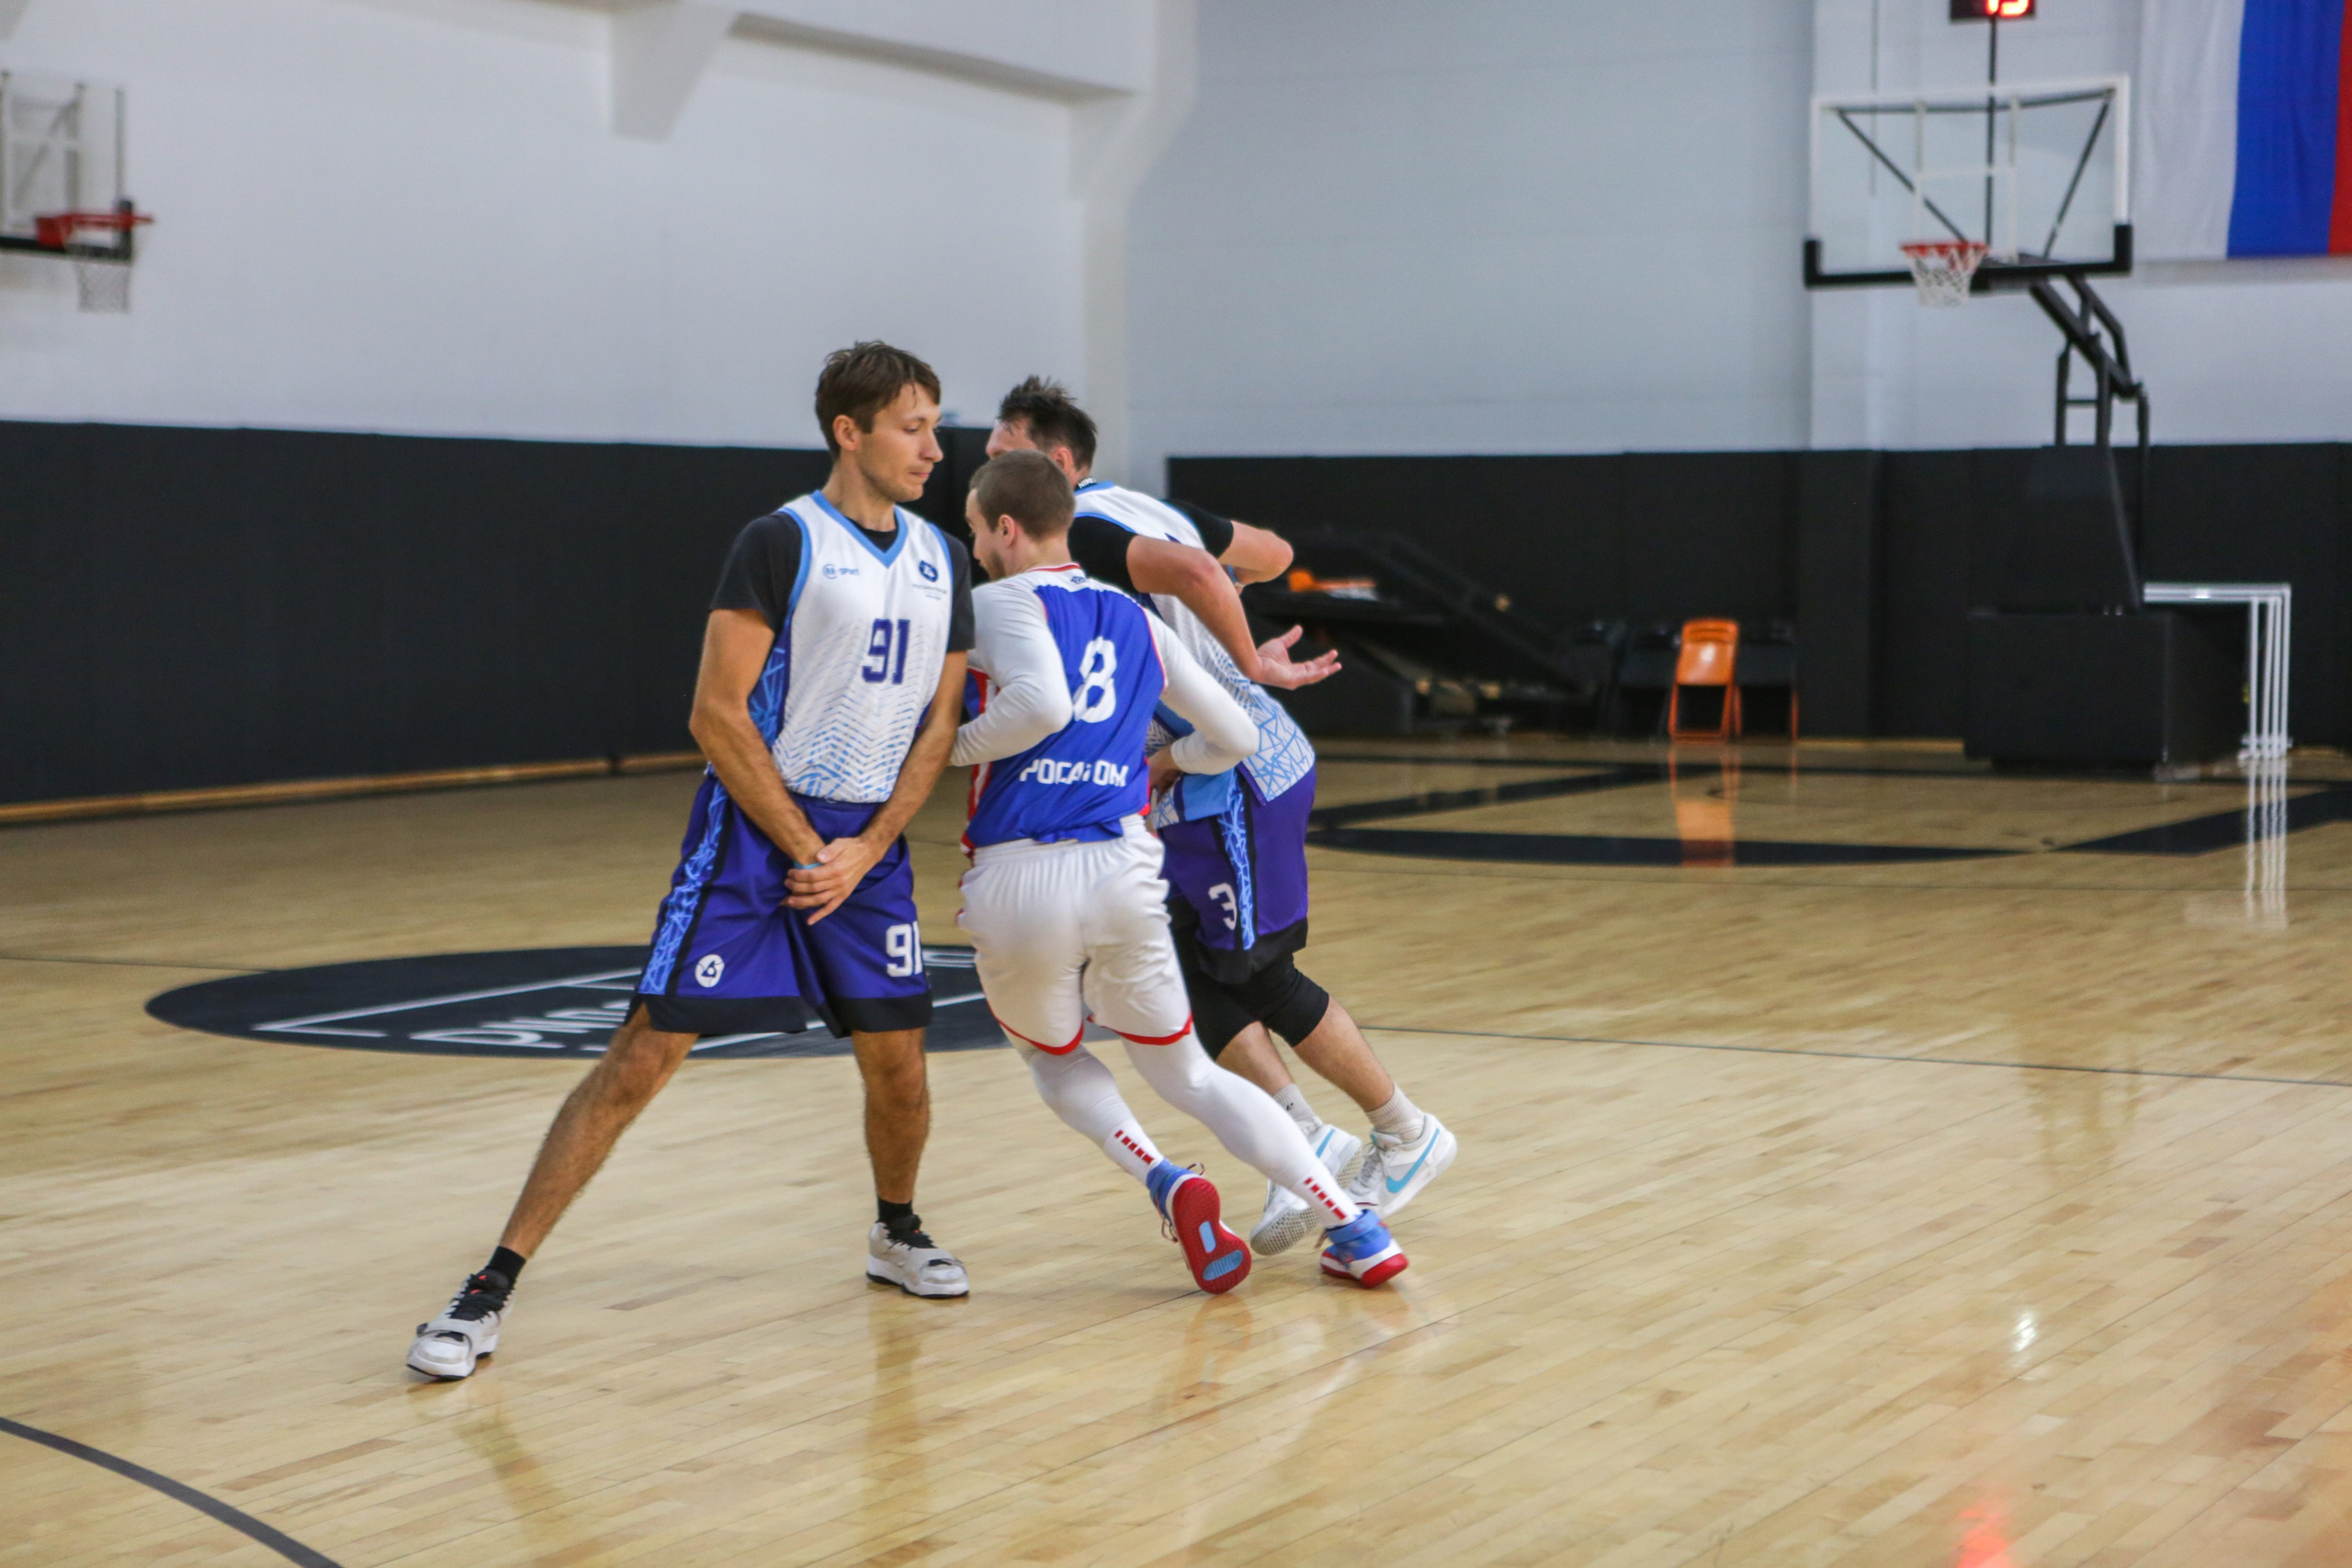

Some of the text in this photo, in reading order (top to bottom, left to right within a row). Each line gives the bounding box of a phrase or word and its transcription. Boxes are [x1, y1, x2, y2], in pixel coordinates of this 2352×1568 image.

[862, 618, 910, 685] 91
[1073, 637, 1117, 723] 8
[1208, 883, 1237, 931] 3
[887, 920, 922, 977] 91
